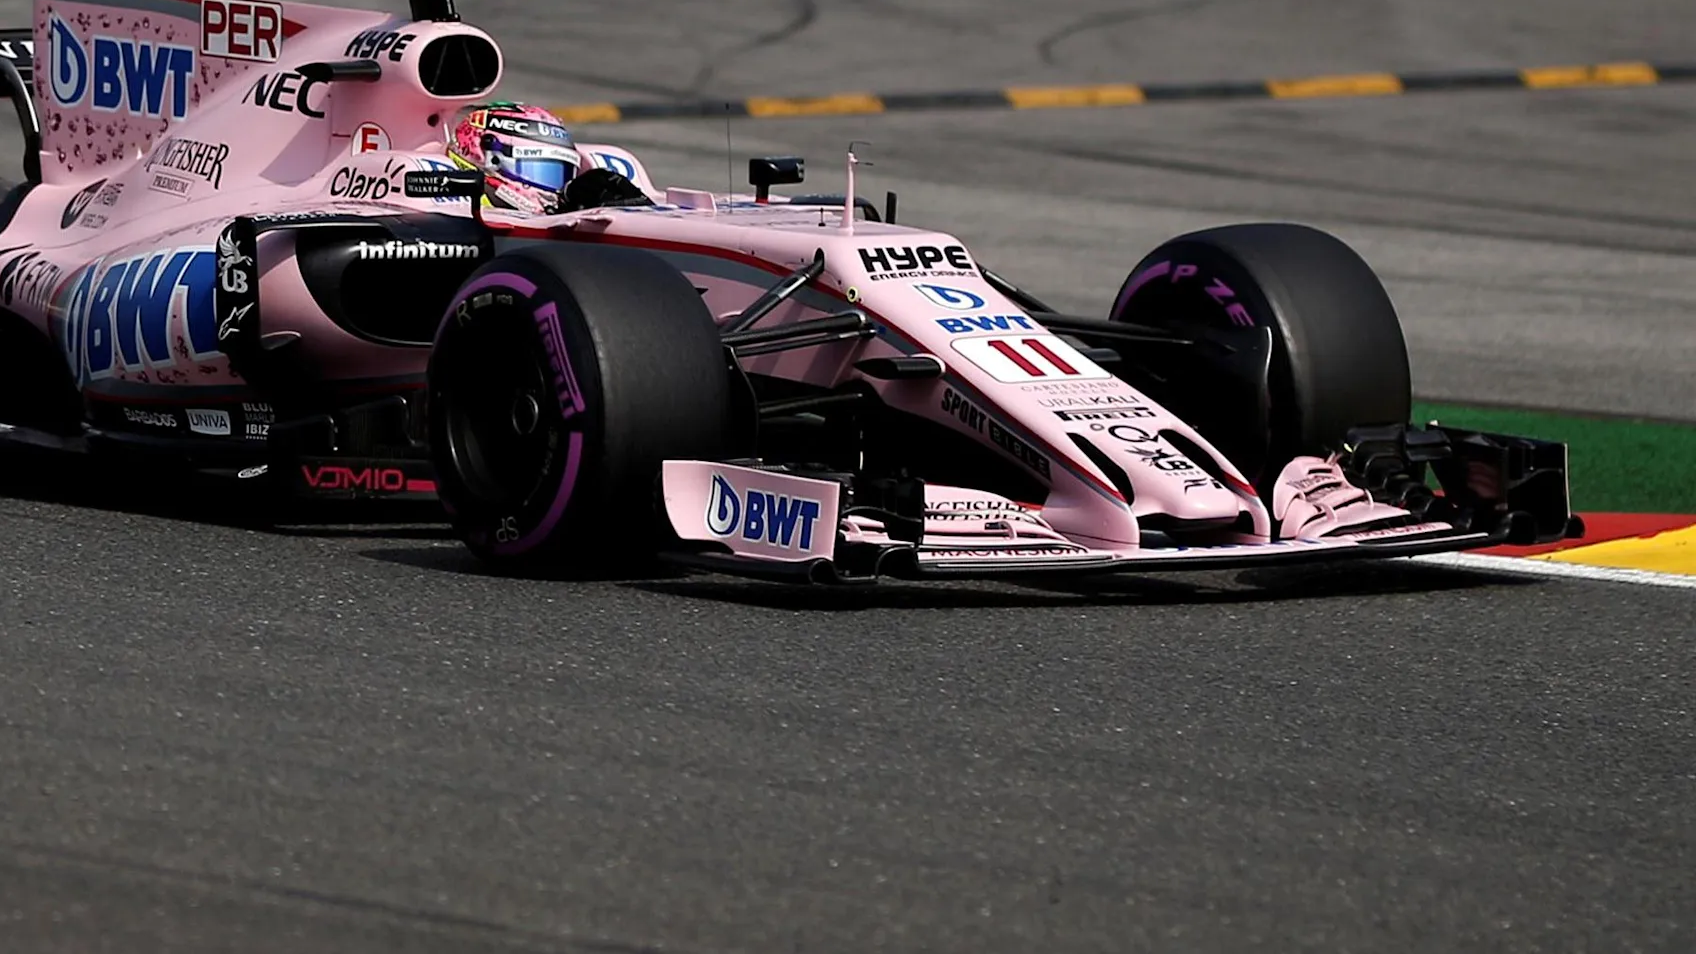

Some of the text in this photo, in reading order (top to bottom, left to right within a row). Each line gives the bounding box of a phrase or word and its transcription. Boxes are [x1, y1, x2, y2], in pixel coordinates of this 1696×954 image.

[204, 1, 279, 58] PER
[344, 31, 417, 62] HYPE
[92, 37, 194, 119] BWT
[241, 71, 329, 119] NEC
[489, 118, 529, 134] NEC
[524, 148, 544, 156] BWT
[330, 166, 389, 200] Claro
[858, 245, 974, 273] HYPE
[870, 271, 927, 281] ENERGY
[1171, 264, 1198, 283] P
[87, 250, 218, 374] BWT
[935, 315, 1035, 334] BWT
[987, 338, 1083, 377] 11
[941, 387, 987, 434] SPORT
[1038, 396, 1141, 408] URALKALI
[123, 407, 178, 428] BARBADOS
[190, 412, 229, 429] UNIVA
[1053, 407, 1157, 422] PIRELLI
[246, 423, 270, 435] IBIZ
[743, 490, 819, 551] BWT
